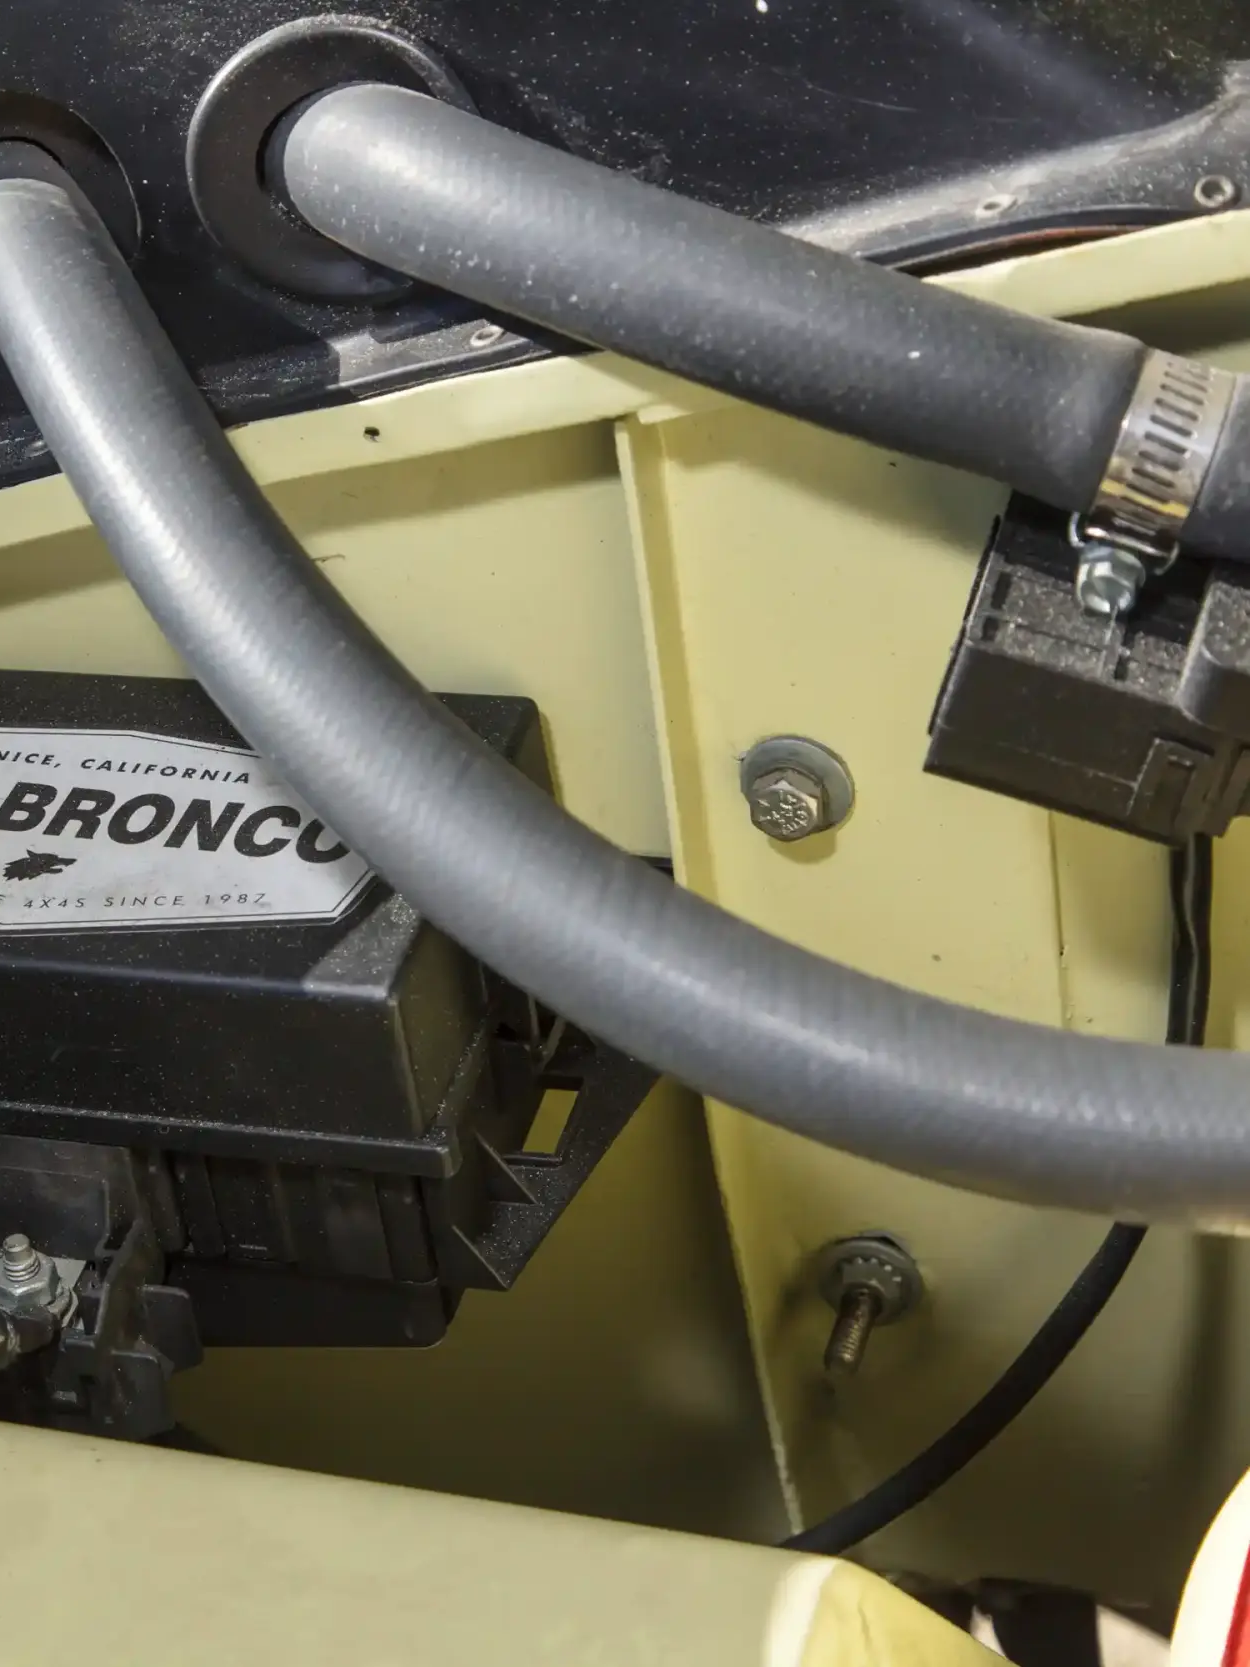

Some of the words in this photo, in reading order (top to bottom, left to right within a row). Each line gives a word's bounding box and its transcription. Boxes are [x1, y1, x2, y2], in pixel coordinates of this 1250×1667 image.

[80, 757, 250, 785] CALIFORNIA
[23, 897, 86, 909] 4X4S
[103, 894, 184, 908] SINCE
[204, 892, 266, 905] 1987
